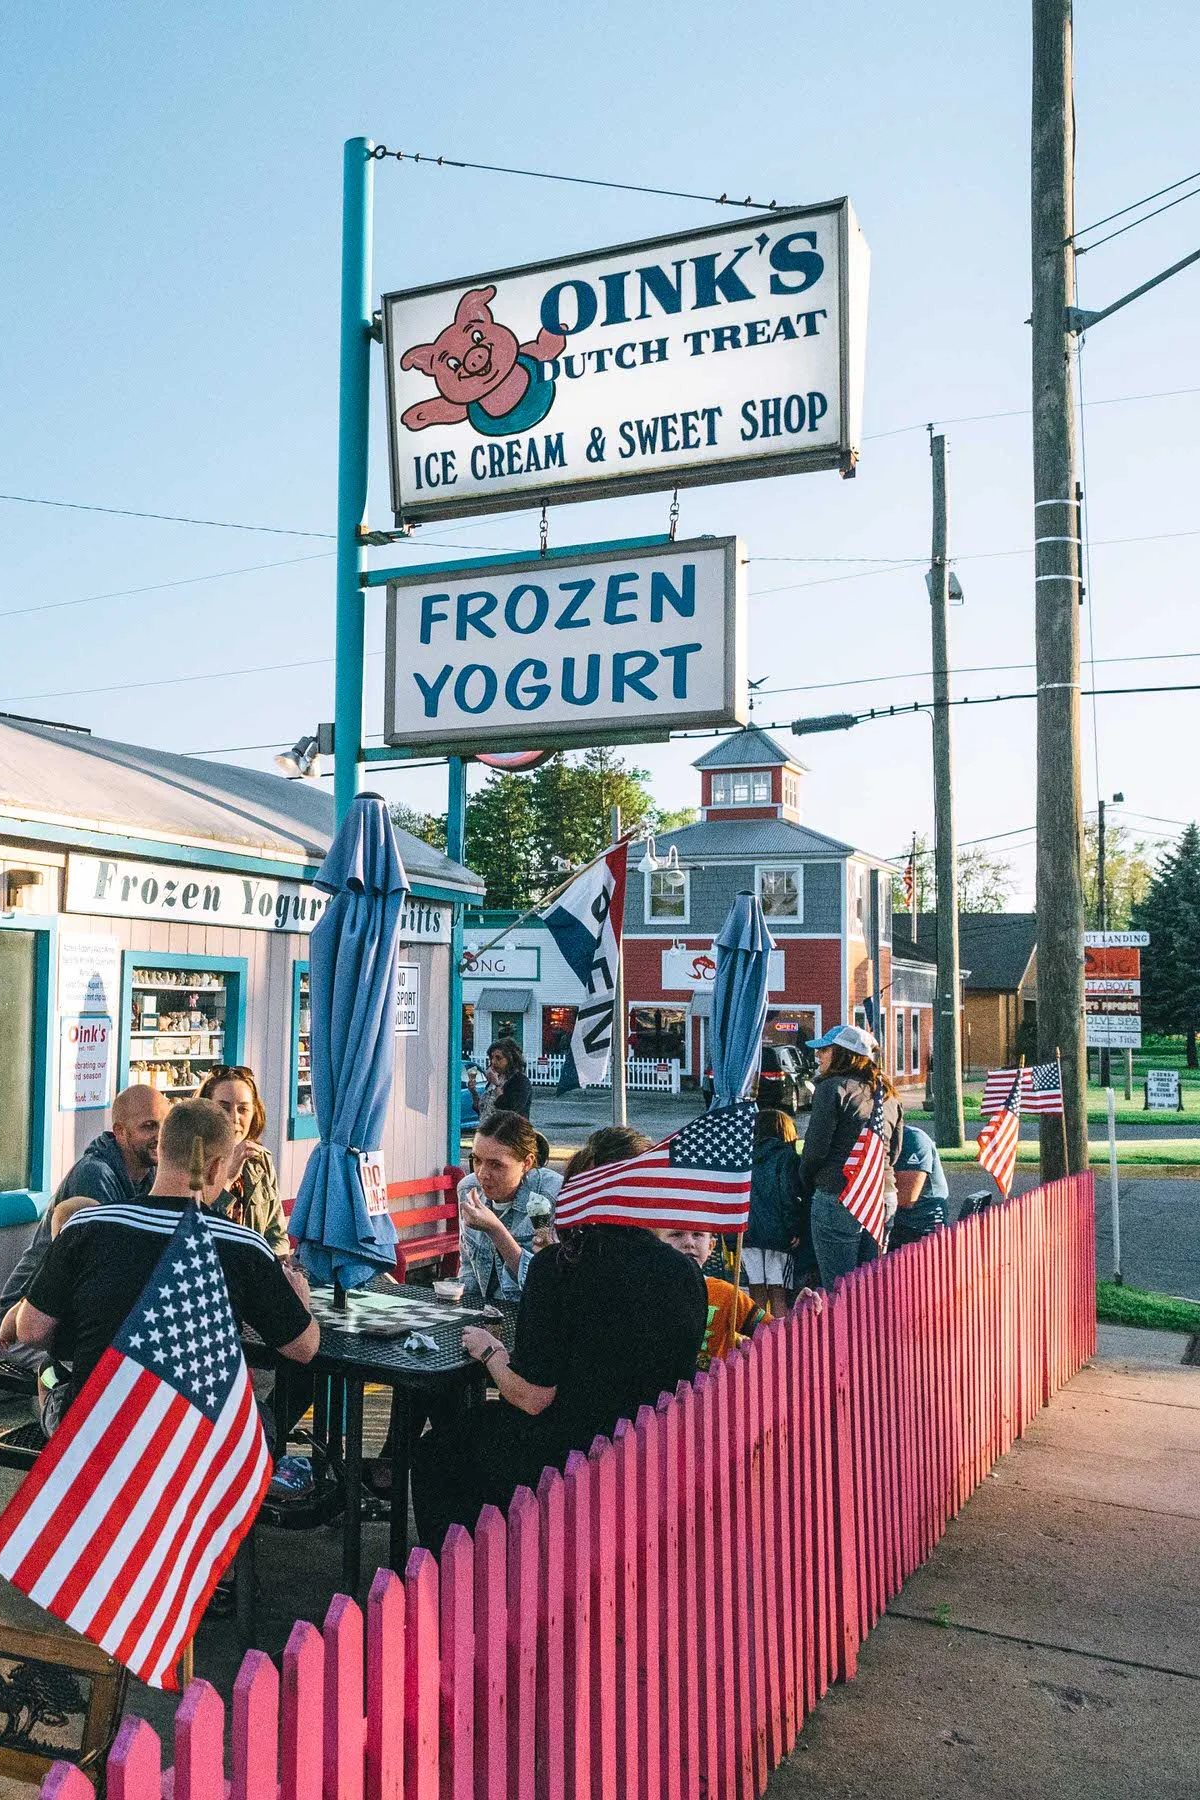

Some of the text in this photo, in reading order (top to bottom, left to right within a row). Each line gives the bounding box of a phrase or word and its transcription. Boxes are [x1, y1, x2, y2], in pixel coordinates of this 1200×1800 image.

[540, 231, 826, 336] OINK'S
[535, 309, 828, 385] DUTCH TREAT
[413, 391, 829, 490] ICE CREAM & SWEET SHOP
[420, 564, 696, 645] FROZEN
[413, 642, 703, 718] YOGURT
[93, 860, 222, 912] Frozen
[1102, 934, 1148, 943] LANDING
[1098, 982, 1134, 990] ABOVE
[397, 992, 416, 1006] SPORT
[396, 1011, 416, 1025] UIRED
[1087, 1016, 1140, 1026] OLVE SPA
[69, 1024, 106, 1043] Oink's
[774, 1022, 797, 1031] OPEN
[1087, 1035, 1138, 1045] hicago Title
[83, 1072, 102, 1080] season
